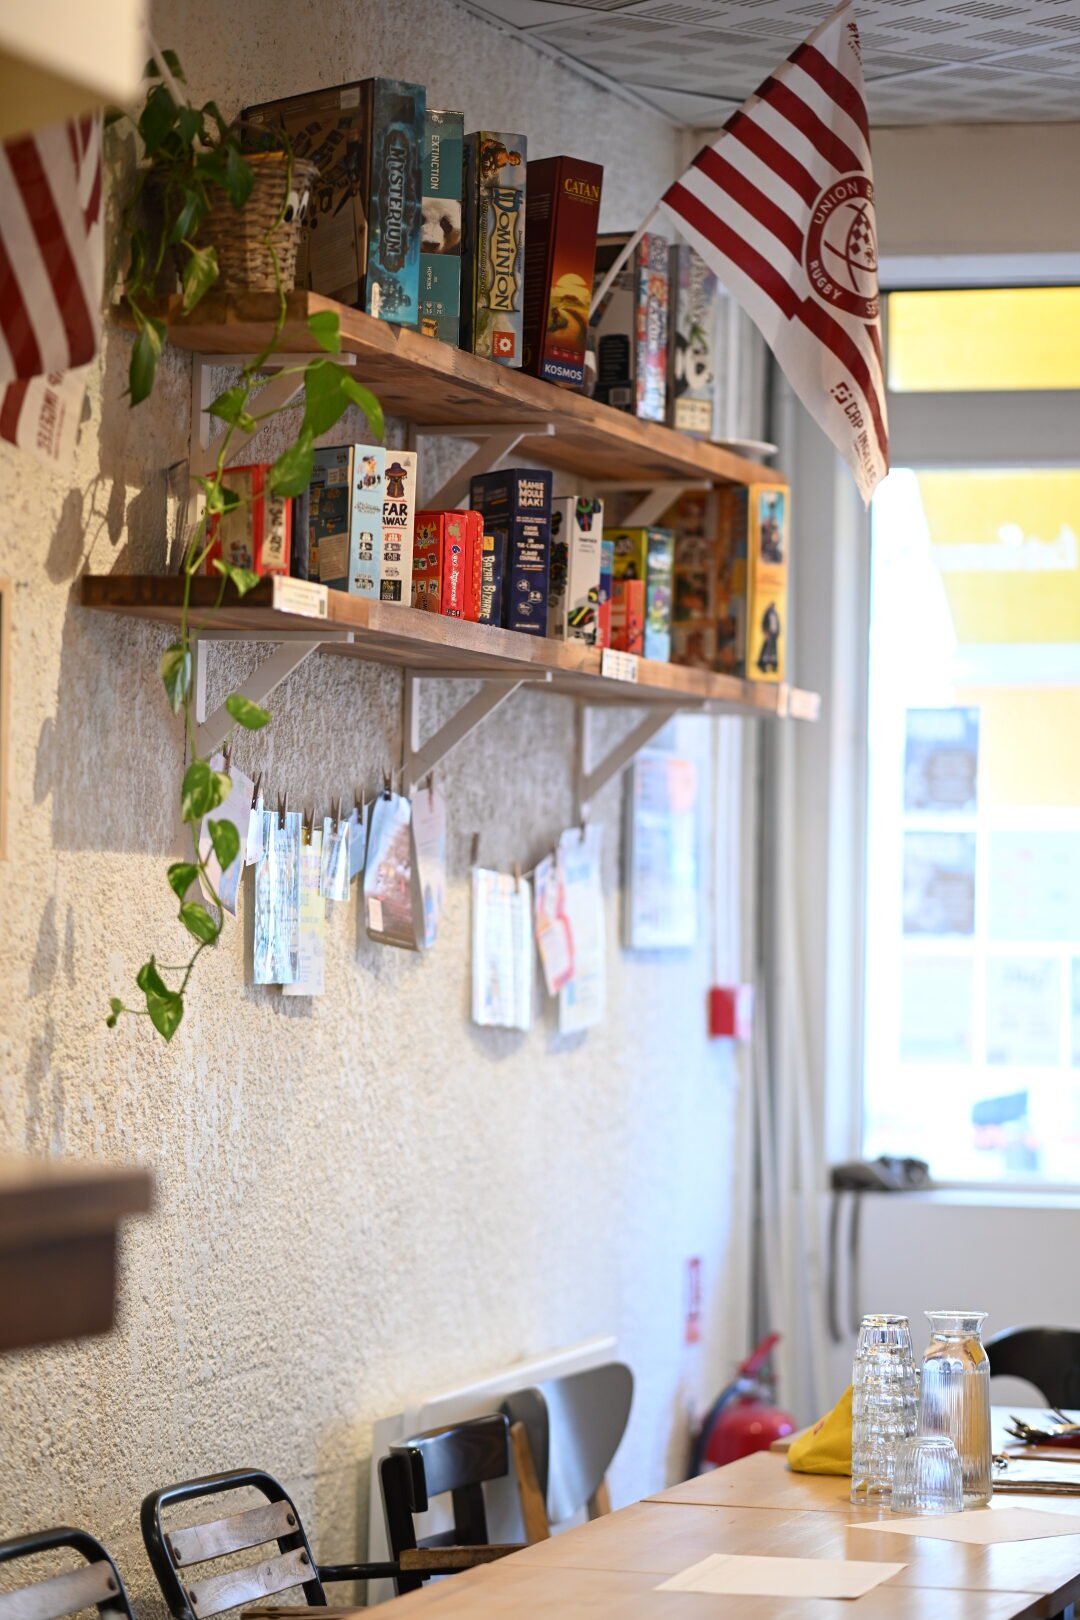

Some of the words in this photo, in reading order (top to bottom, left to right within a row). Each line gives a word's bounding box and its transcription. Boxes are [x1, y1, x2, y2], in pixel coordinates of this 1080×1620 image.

[429, 134, 440, 190] EXTINCTION
[384, 144, 407, 256] MYSTERIUM
[564, 178, 600, 199] CATAN
[813, 181, 859, 225] UNION
[809, 260, 843, 300] RUGBY
[544, 364, 582, 380] KOSMOS
[844, 401, 864, 429] CAP
[382, 502, 408, 516] FAR
[518, 497, 544, 507] MAKI
[481, 555, 495, 582] BAZAR
[480, 585, 497, 619] BIZARRE
